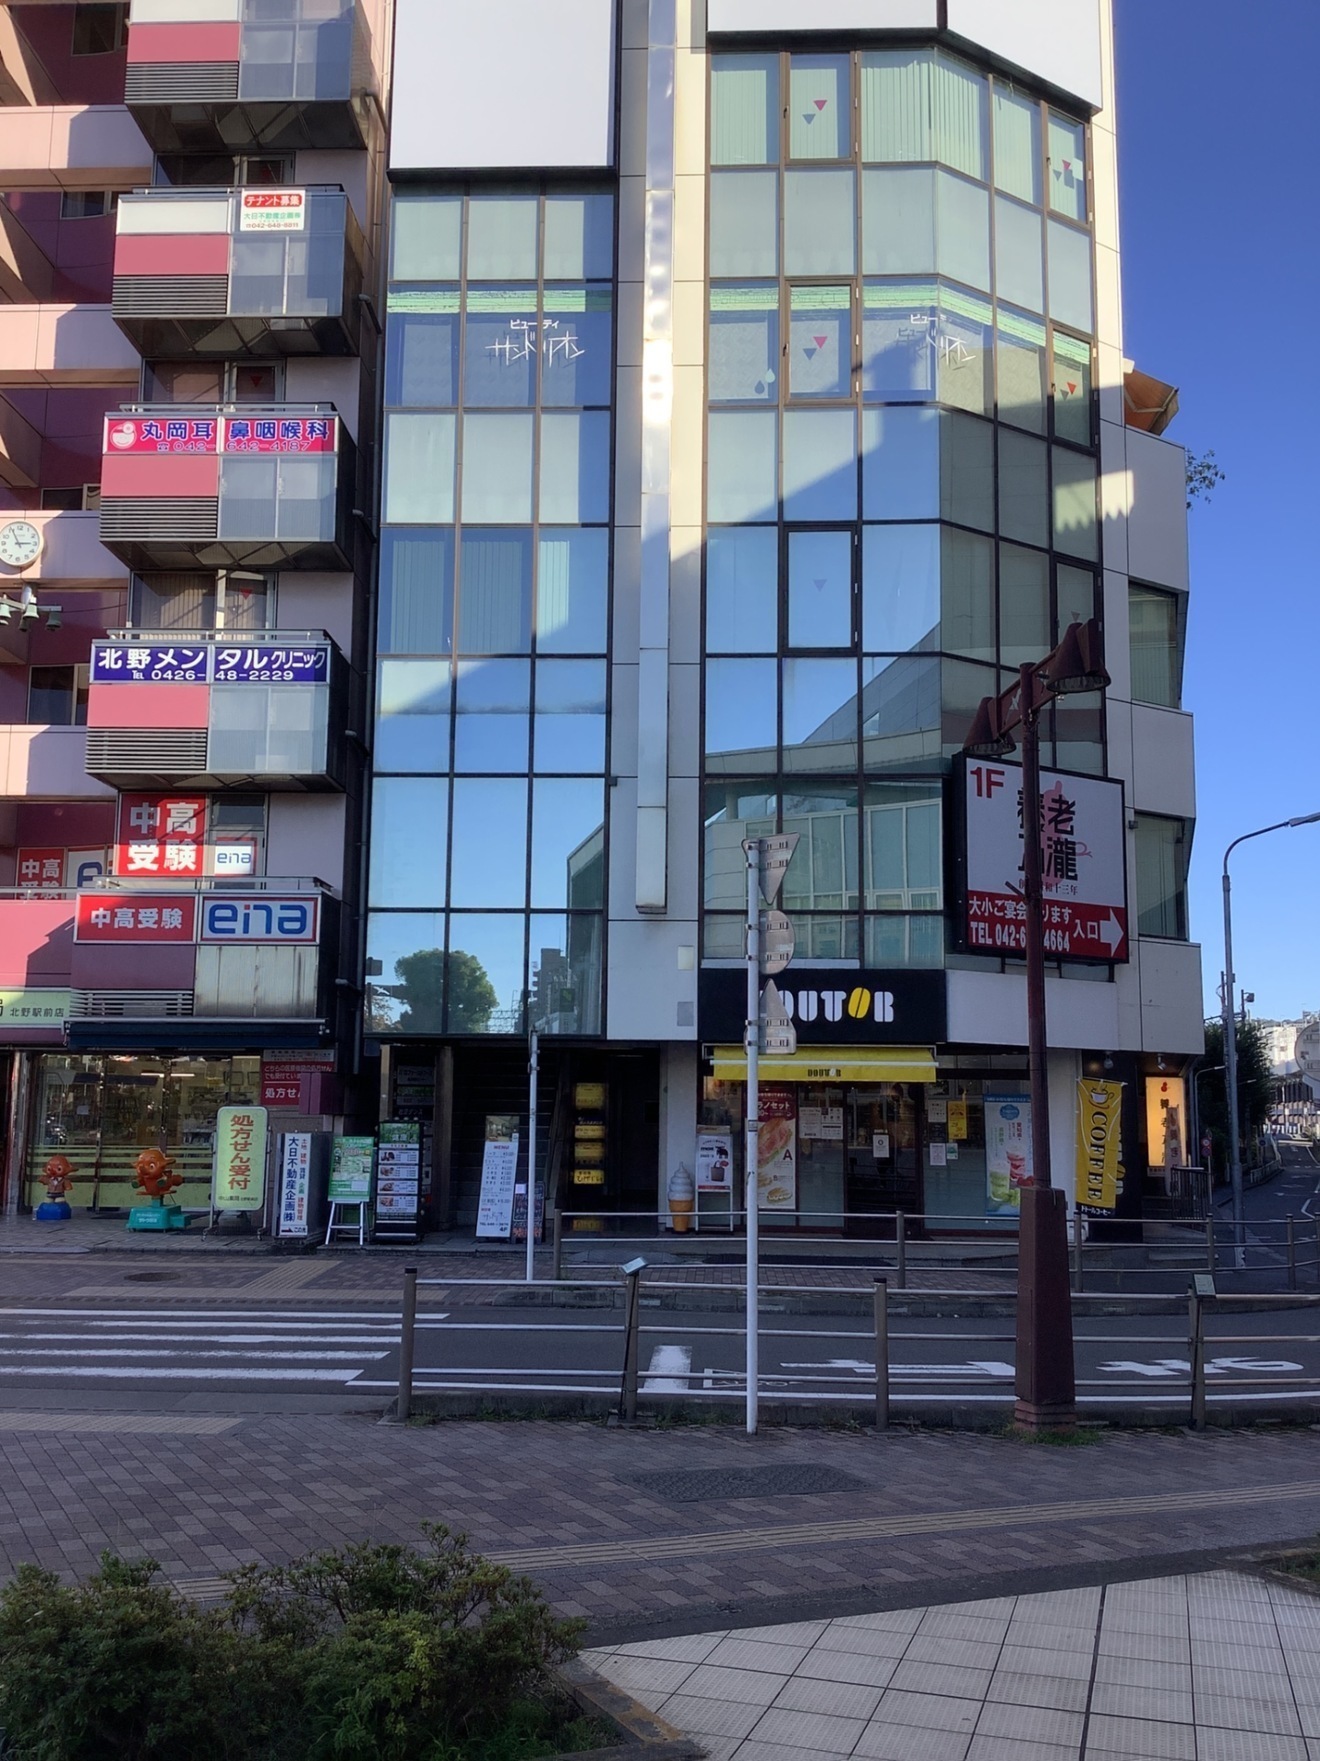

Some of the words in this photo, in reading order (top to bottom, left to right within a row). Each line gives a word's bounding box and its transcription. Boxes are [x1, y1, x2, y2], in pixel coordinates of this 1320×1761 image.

[246, 195, 300, 206] テナント募集
[510, 319, 560, 329] ビューティ
[141, 420, 329, 440] 丸岡耳鼻咽喉科
[173, 441, 312, 451] 042-642-4187
[98, 648, 326, 669] 北野メンタルクリニック
[132, 670, 145, 680] TEL
[151, 670, 294, 681] 0426-48-2229
[970, 767, 1005, 798] 1F
[129, 801, 199, 835] 中高
[127, 839, 198, 872] 受験
[21, 858, 61, 878] 中高
[90, 907, 183, 930] 中高受験
[968, 898, 1072, 924] 大小ご宴会ります
[970, 922, 993, 945] TEL
[995, 923, 1070, 952] 042-64664
[1073, 918, 1099, 940] 入口
[10, 1007, 65, 1017] 北野駅前店
[807, 1068, 842, 1077] DOUTOR
[227, 1114, 255, 1190] 処方せん受付
[782, 1149, 793, 1161] A
[1087, 1111, 1108, 1201] COFFEE
